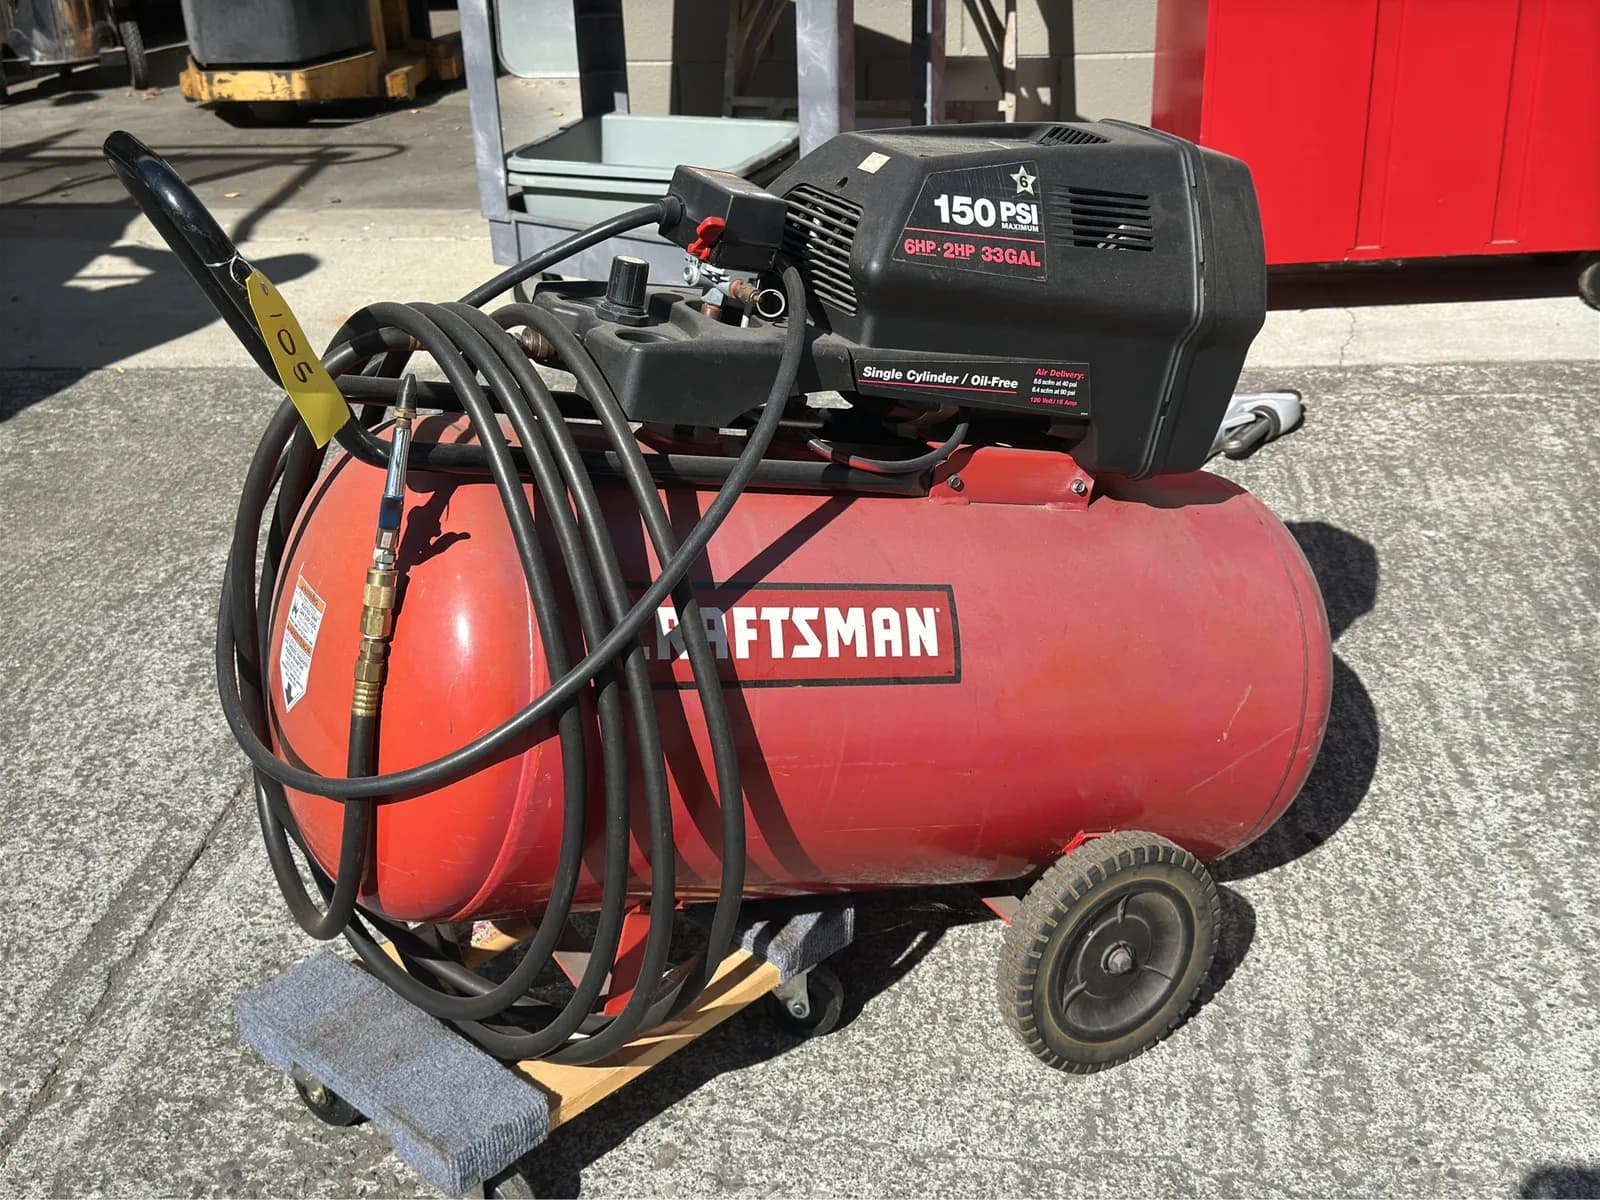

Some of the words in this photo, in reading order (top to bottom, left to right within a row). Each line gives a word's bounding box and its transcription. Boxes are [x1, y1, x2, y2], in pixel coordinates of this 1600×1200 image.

[1019, 175, 1029, 188] 6
[934, 194, 996, 228] 150
[1000, 201, 1039, 225] PSI
[1001, 222, 1039, 232] MAXIMUM
[981, 246, 1041, 267] 33GAL
[862, 366, 903, 381] Single
[906, 369, 960, 385] Cylinder
[961, 373, 969, 385] /
[971, 374, 1018, 389] Oil-Free
[1035, 367, 1048, 376] Air
[1050, 369, 1085, 380] Delivery:
[643, 606, 939, 660] RAFTSMAN
